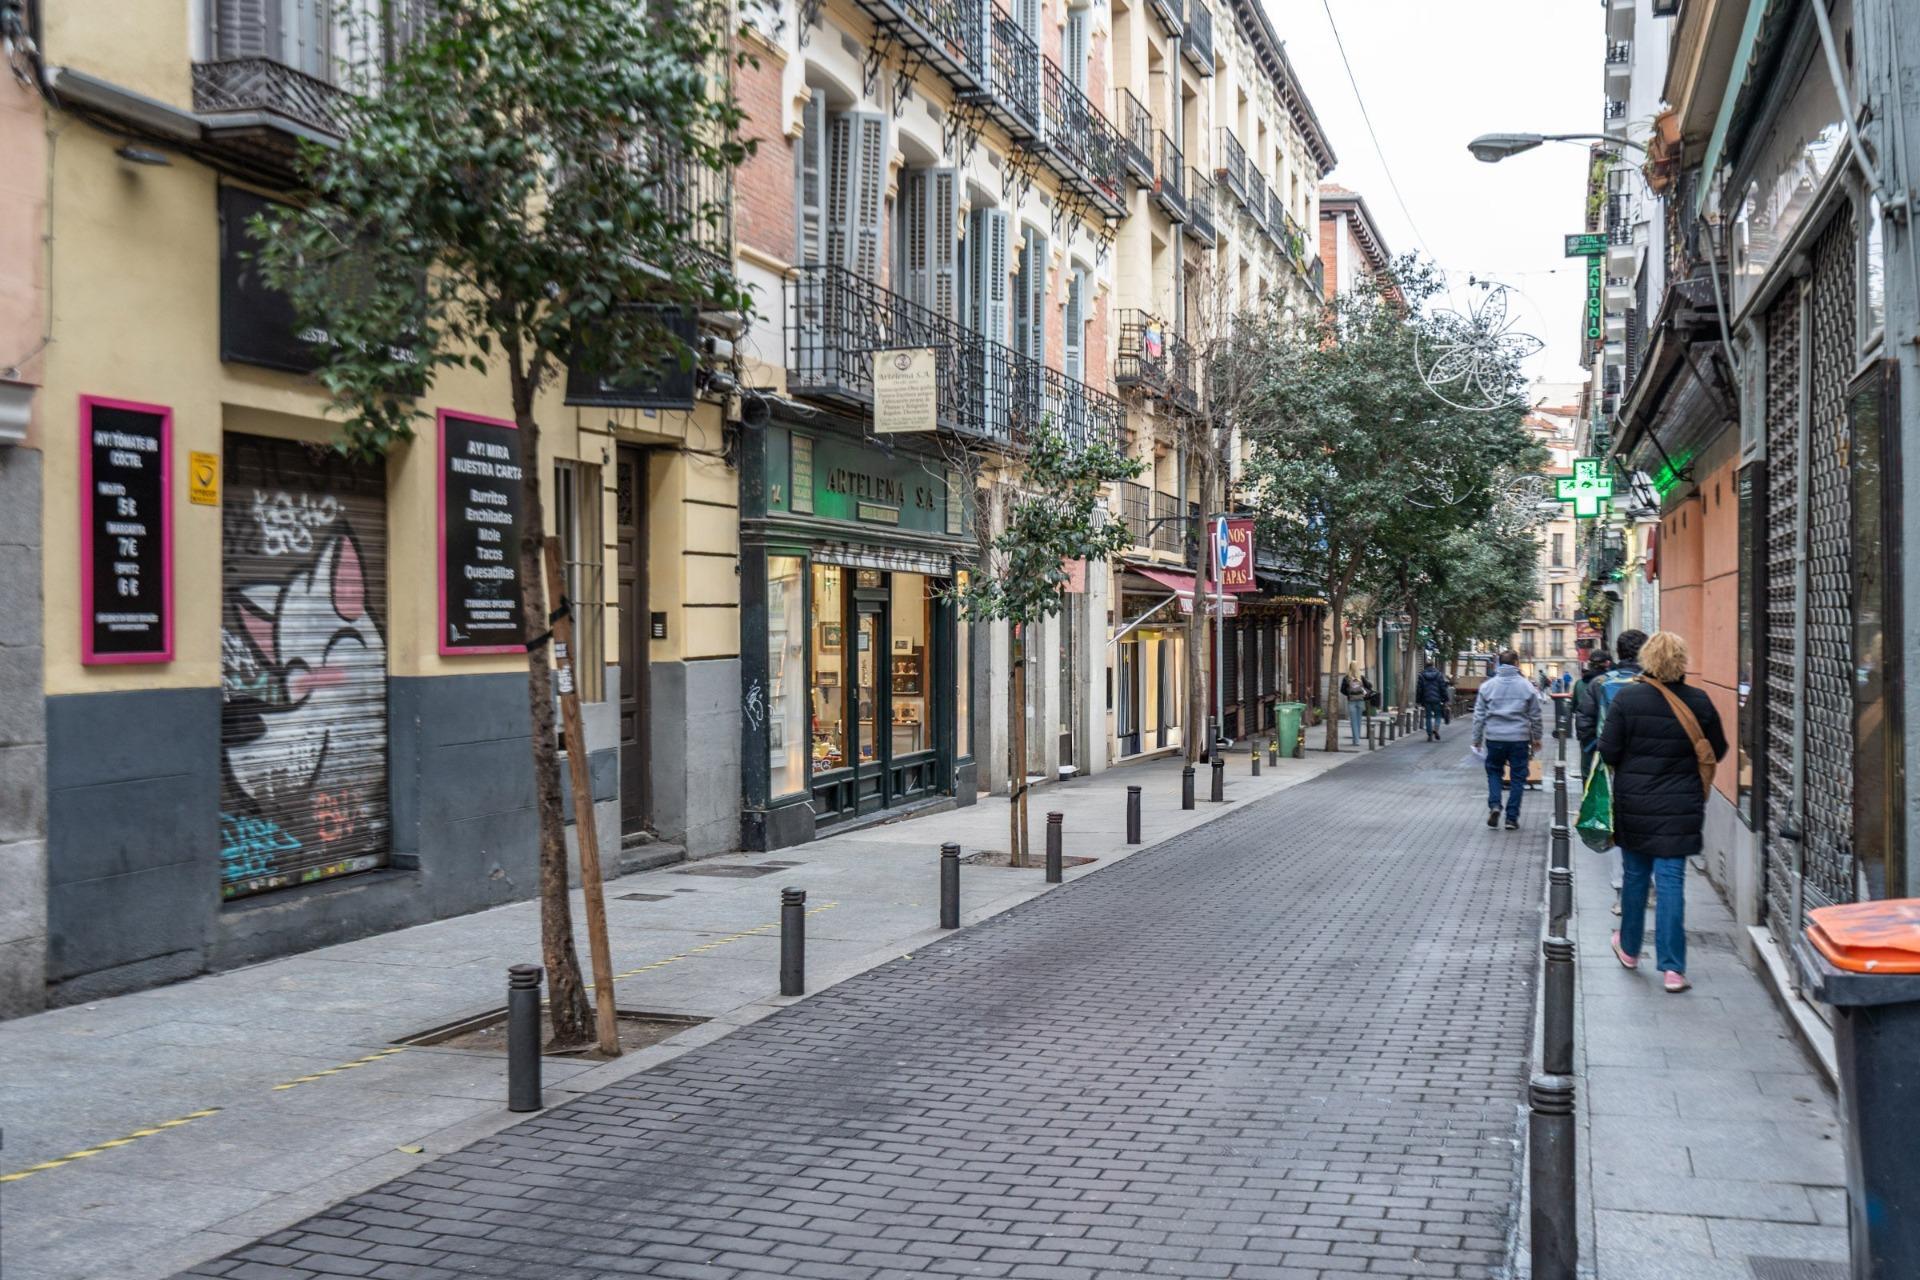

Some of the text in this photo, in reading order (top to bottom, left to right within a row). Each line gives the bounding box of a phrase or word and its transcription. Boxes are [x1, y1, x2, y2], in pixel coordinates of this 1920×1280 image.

[452, 457, 495, 478] NUESTRA
[470, 488, 508, 506] Burritos
[465, 507, 513, 525] Enchiladas
[478, 527, 501, 542] Mole
[476, 547, 503, 561] Tacos
[464, 564, 515, 580] Quesadillas
